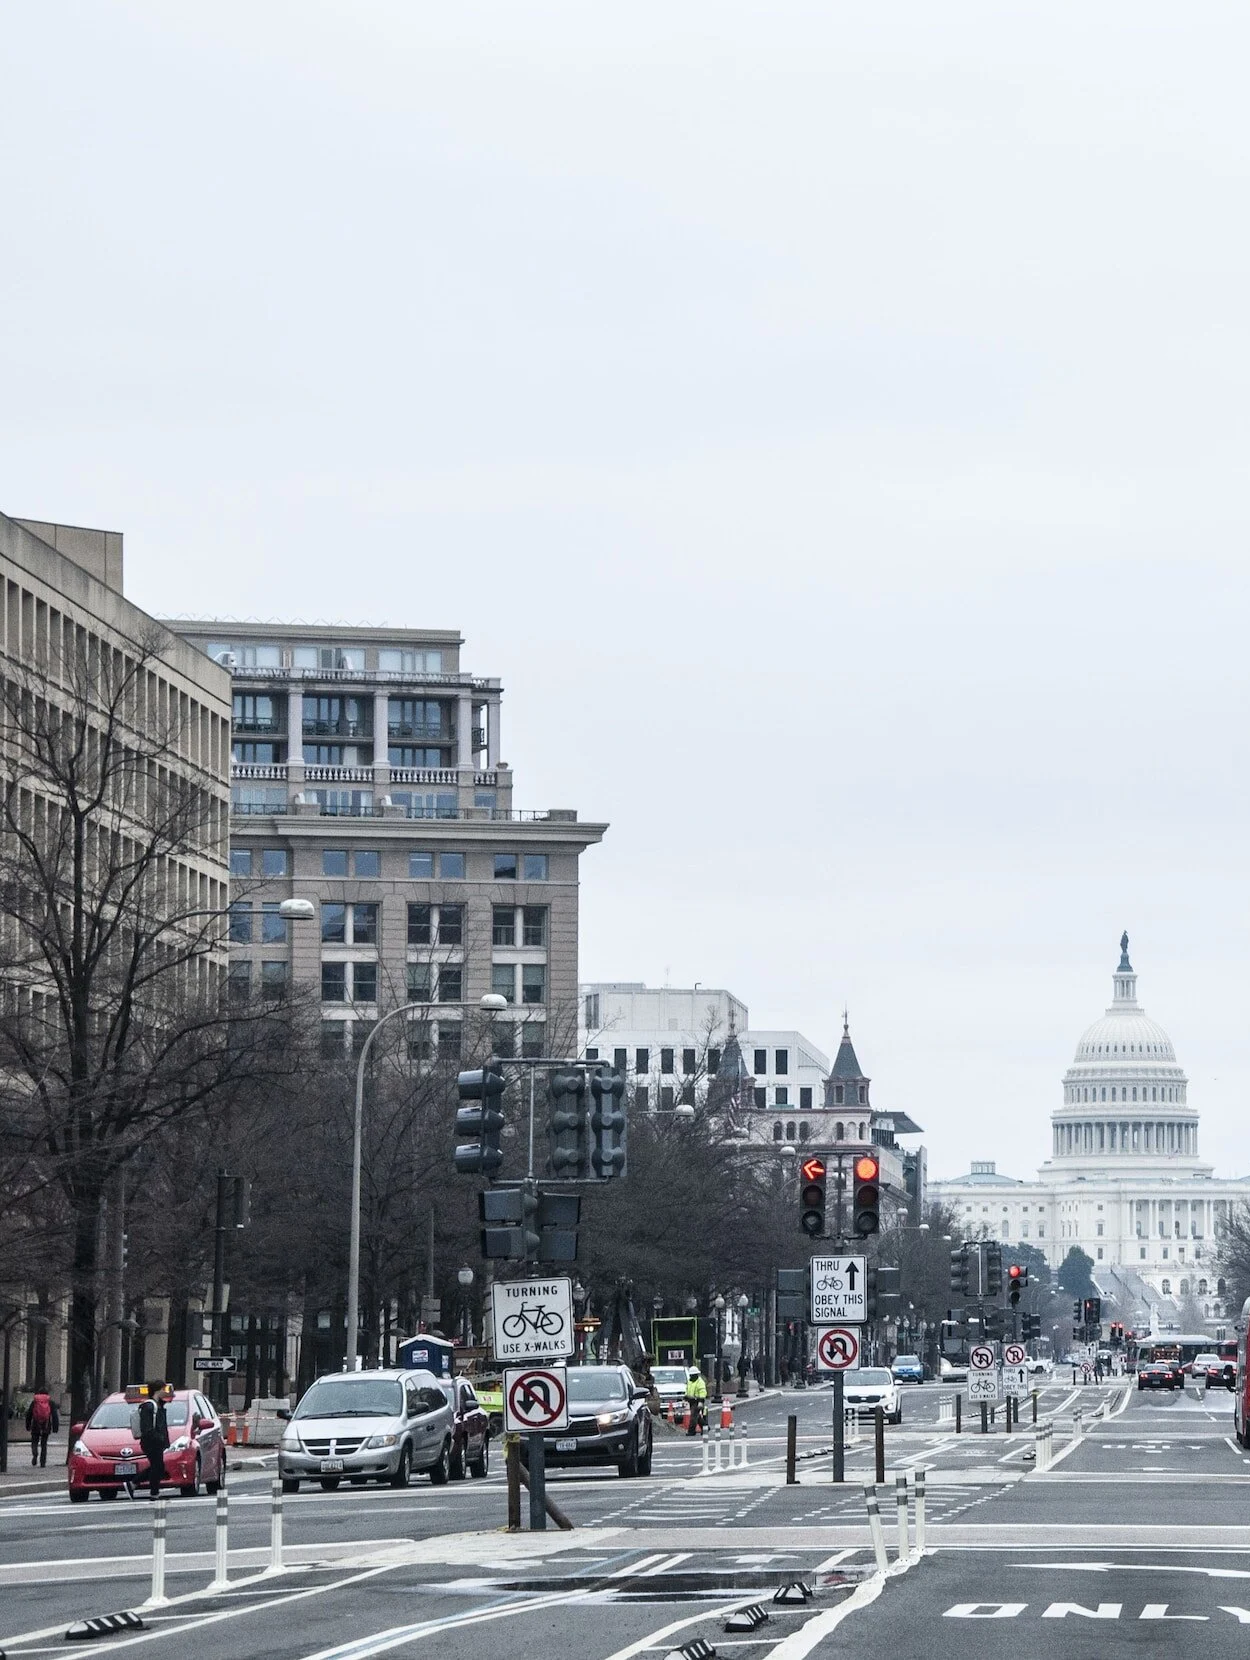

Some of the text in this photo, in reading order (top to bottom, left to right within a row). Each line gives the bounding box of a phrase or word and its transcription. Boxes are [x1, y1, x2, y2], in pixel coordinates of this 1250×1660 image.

[815, 1260, 840, 1271] THRU
[506, 1285, 558, 1298] TURNING
[815, 1294, 863, 1305] OBEY THIS
[815, 1307, 848, 1318] SIGNAL
[502, 1340, 566, 1354] USE X-WALKS
